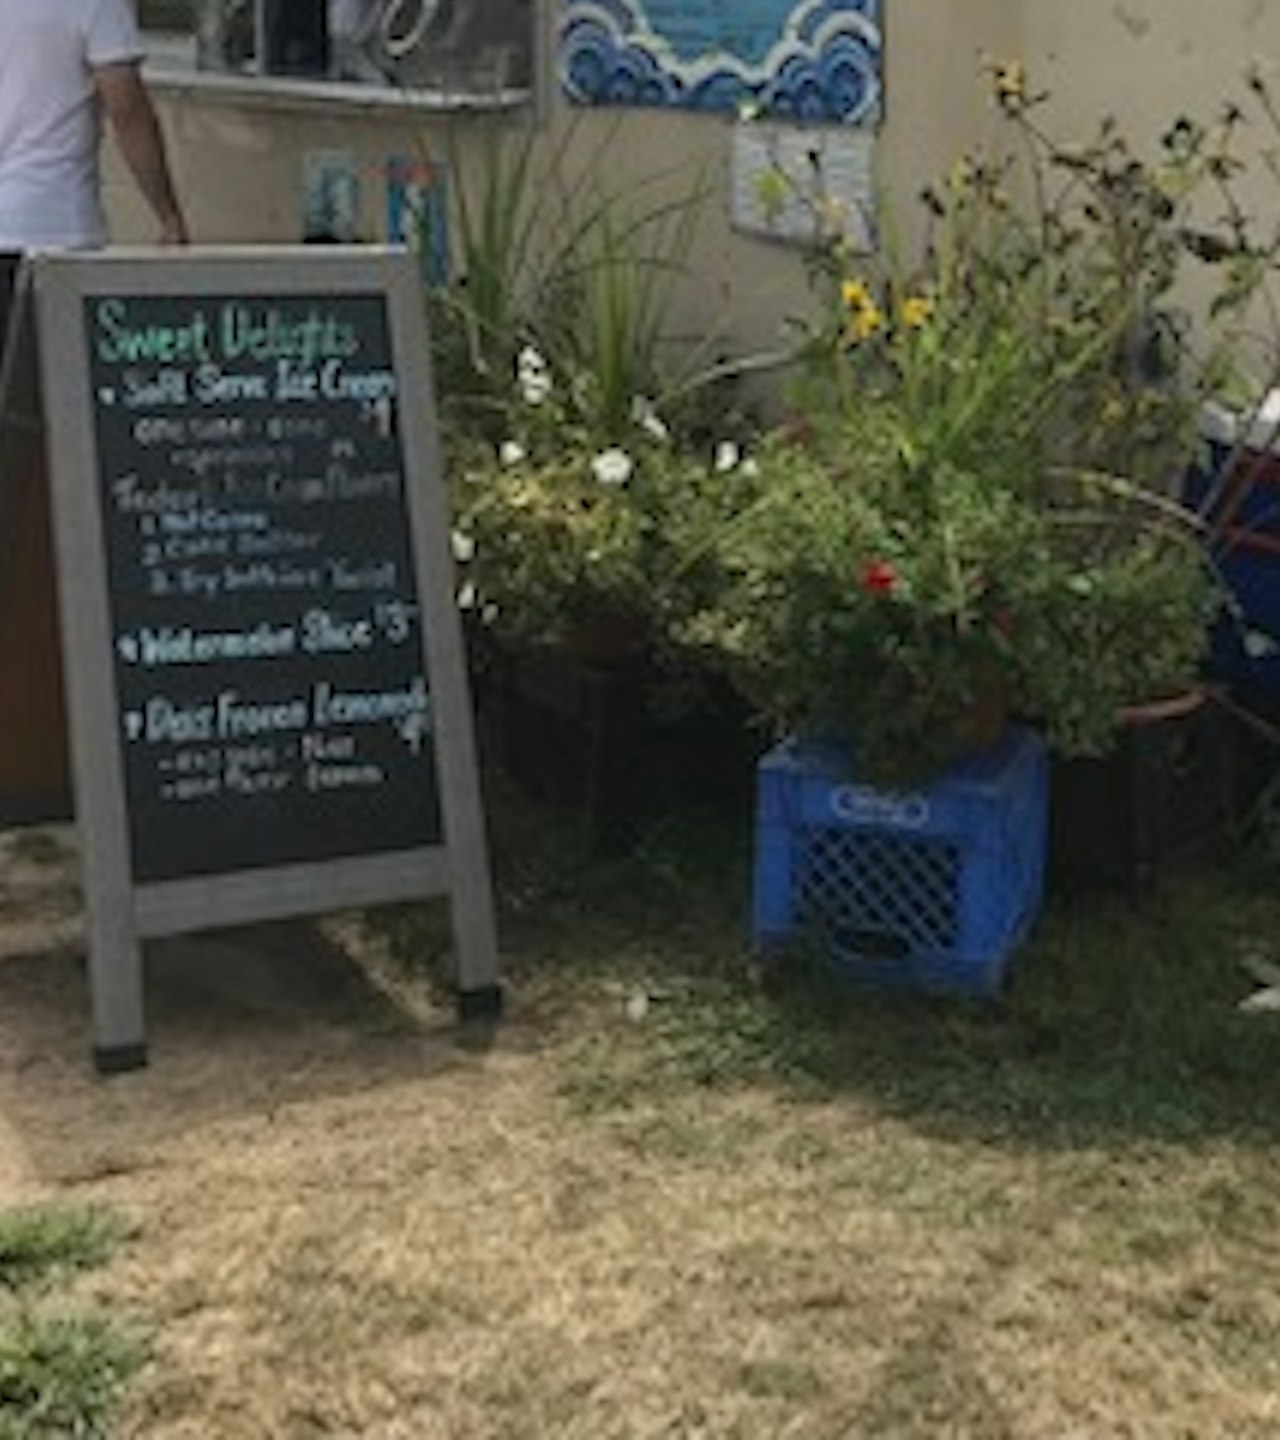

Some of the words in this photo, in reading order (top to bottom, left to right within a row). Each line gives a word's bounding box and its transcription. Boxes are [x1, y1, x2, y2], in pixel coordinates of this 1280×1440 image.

[97, 298, 212, 362] Sweet
[222, 302, 358, 364] Delights
[194, 362, 268, 402] Serve
[276, 358, 318, 400] Ice
[322, 357, 398, 398] Cream
